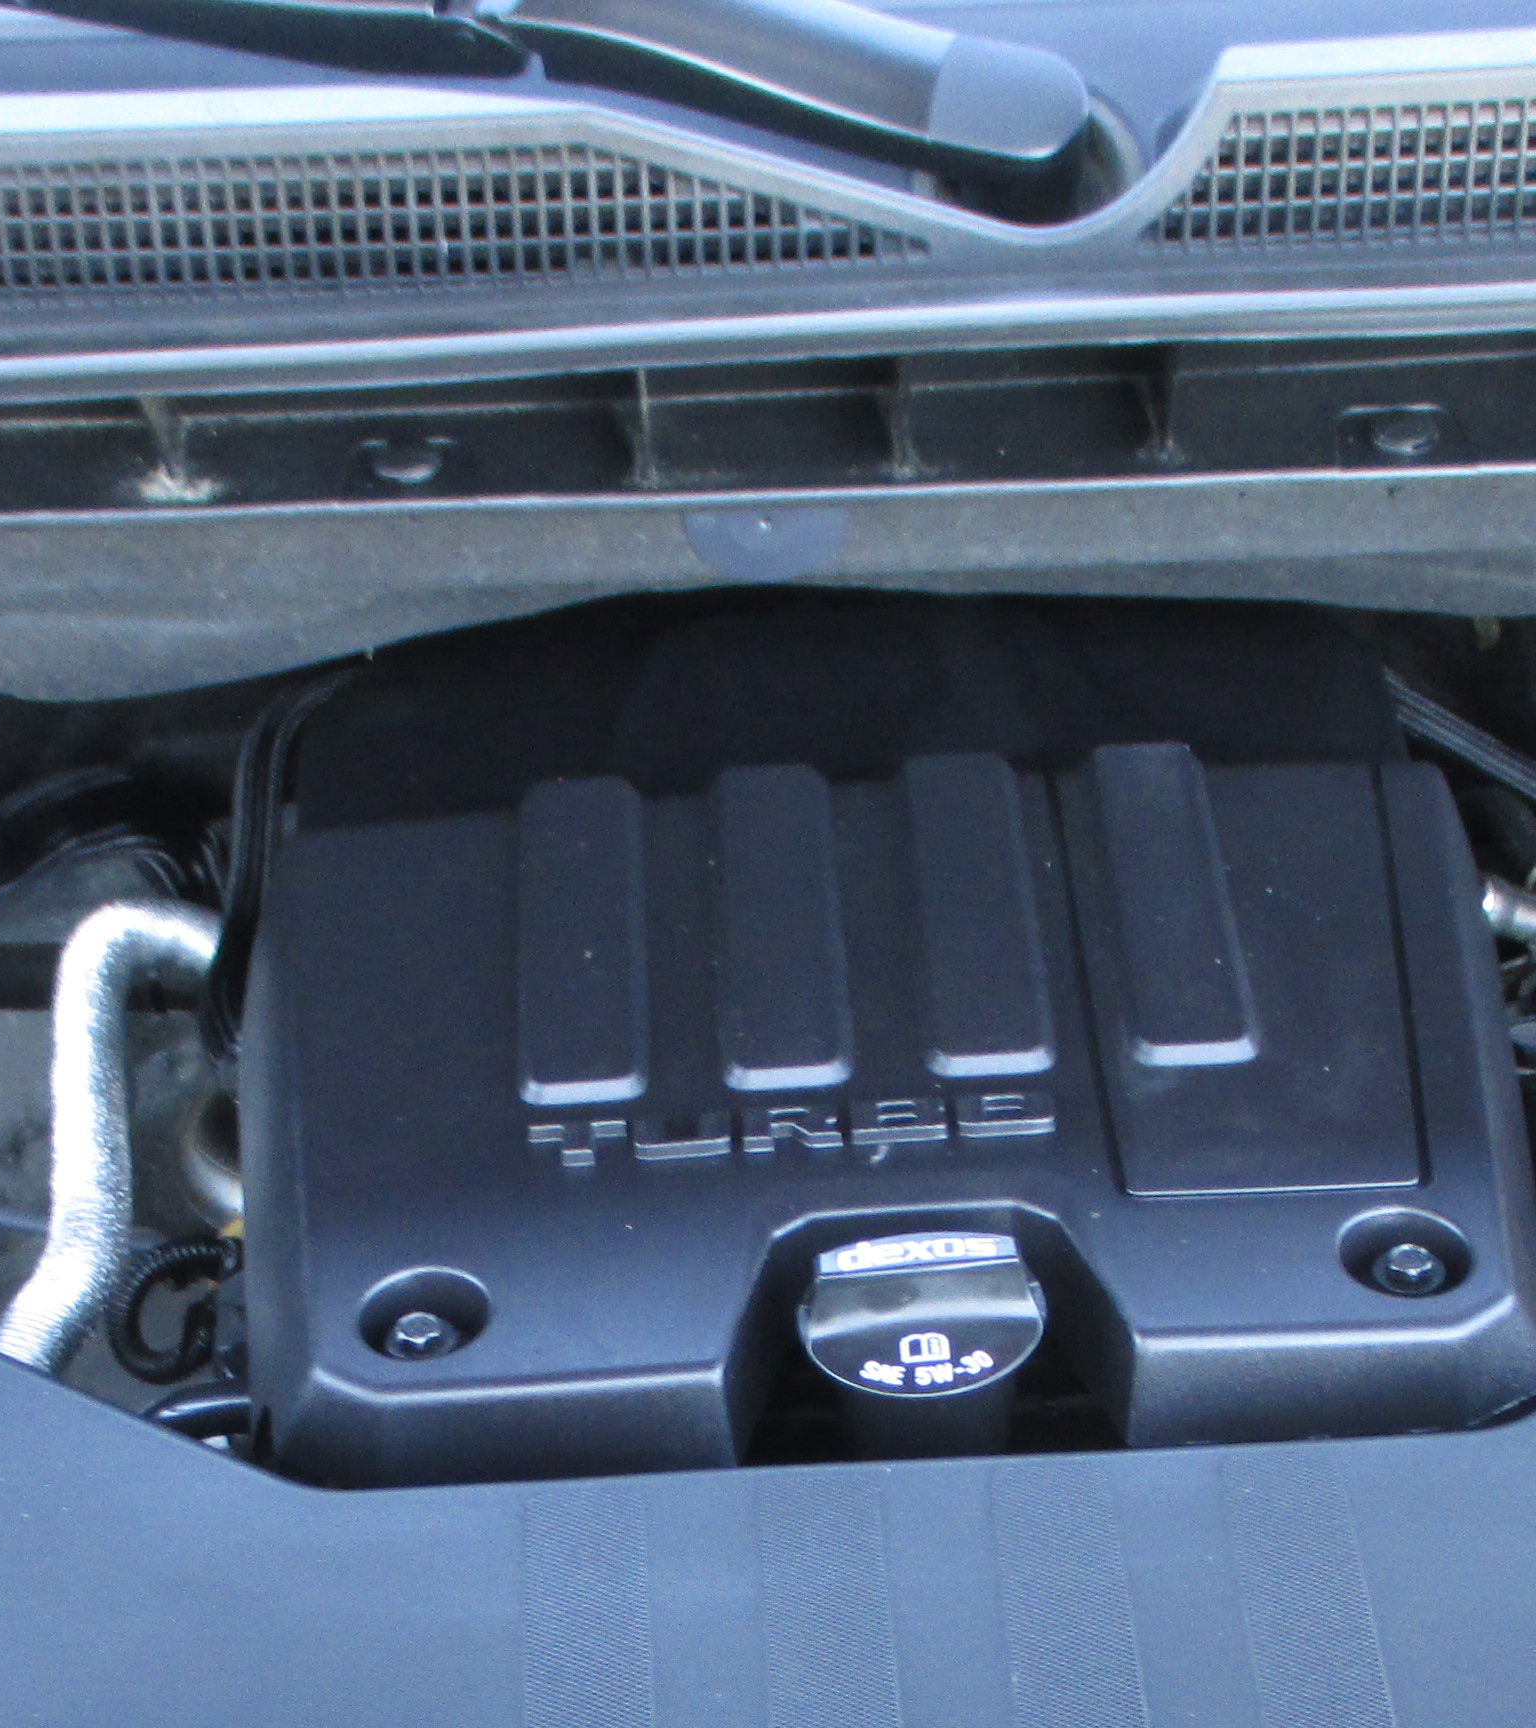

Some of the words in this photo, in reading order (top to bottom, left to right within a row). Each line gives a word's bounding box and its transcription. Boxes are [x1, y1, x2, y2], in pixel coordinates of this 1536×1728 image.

[527, 1092, 1057, 1168] TURBO
[836, 1237, 999, 1272] dexos
[858, 1360, 907, 1386] SAE
[914, 1350, 994, 1386] 5W-30
